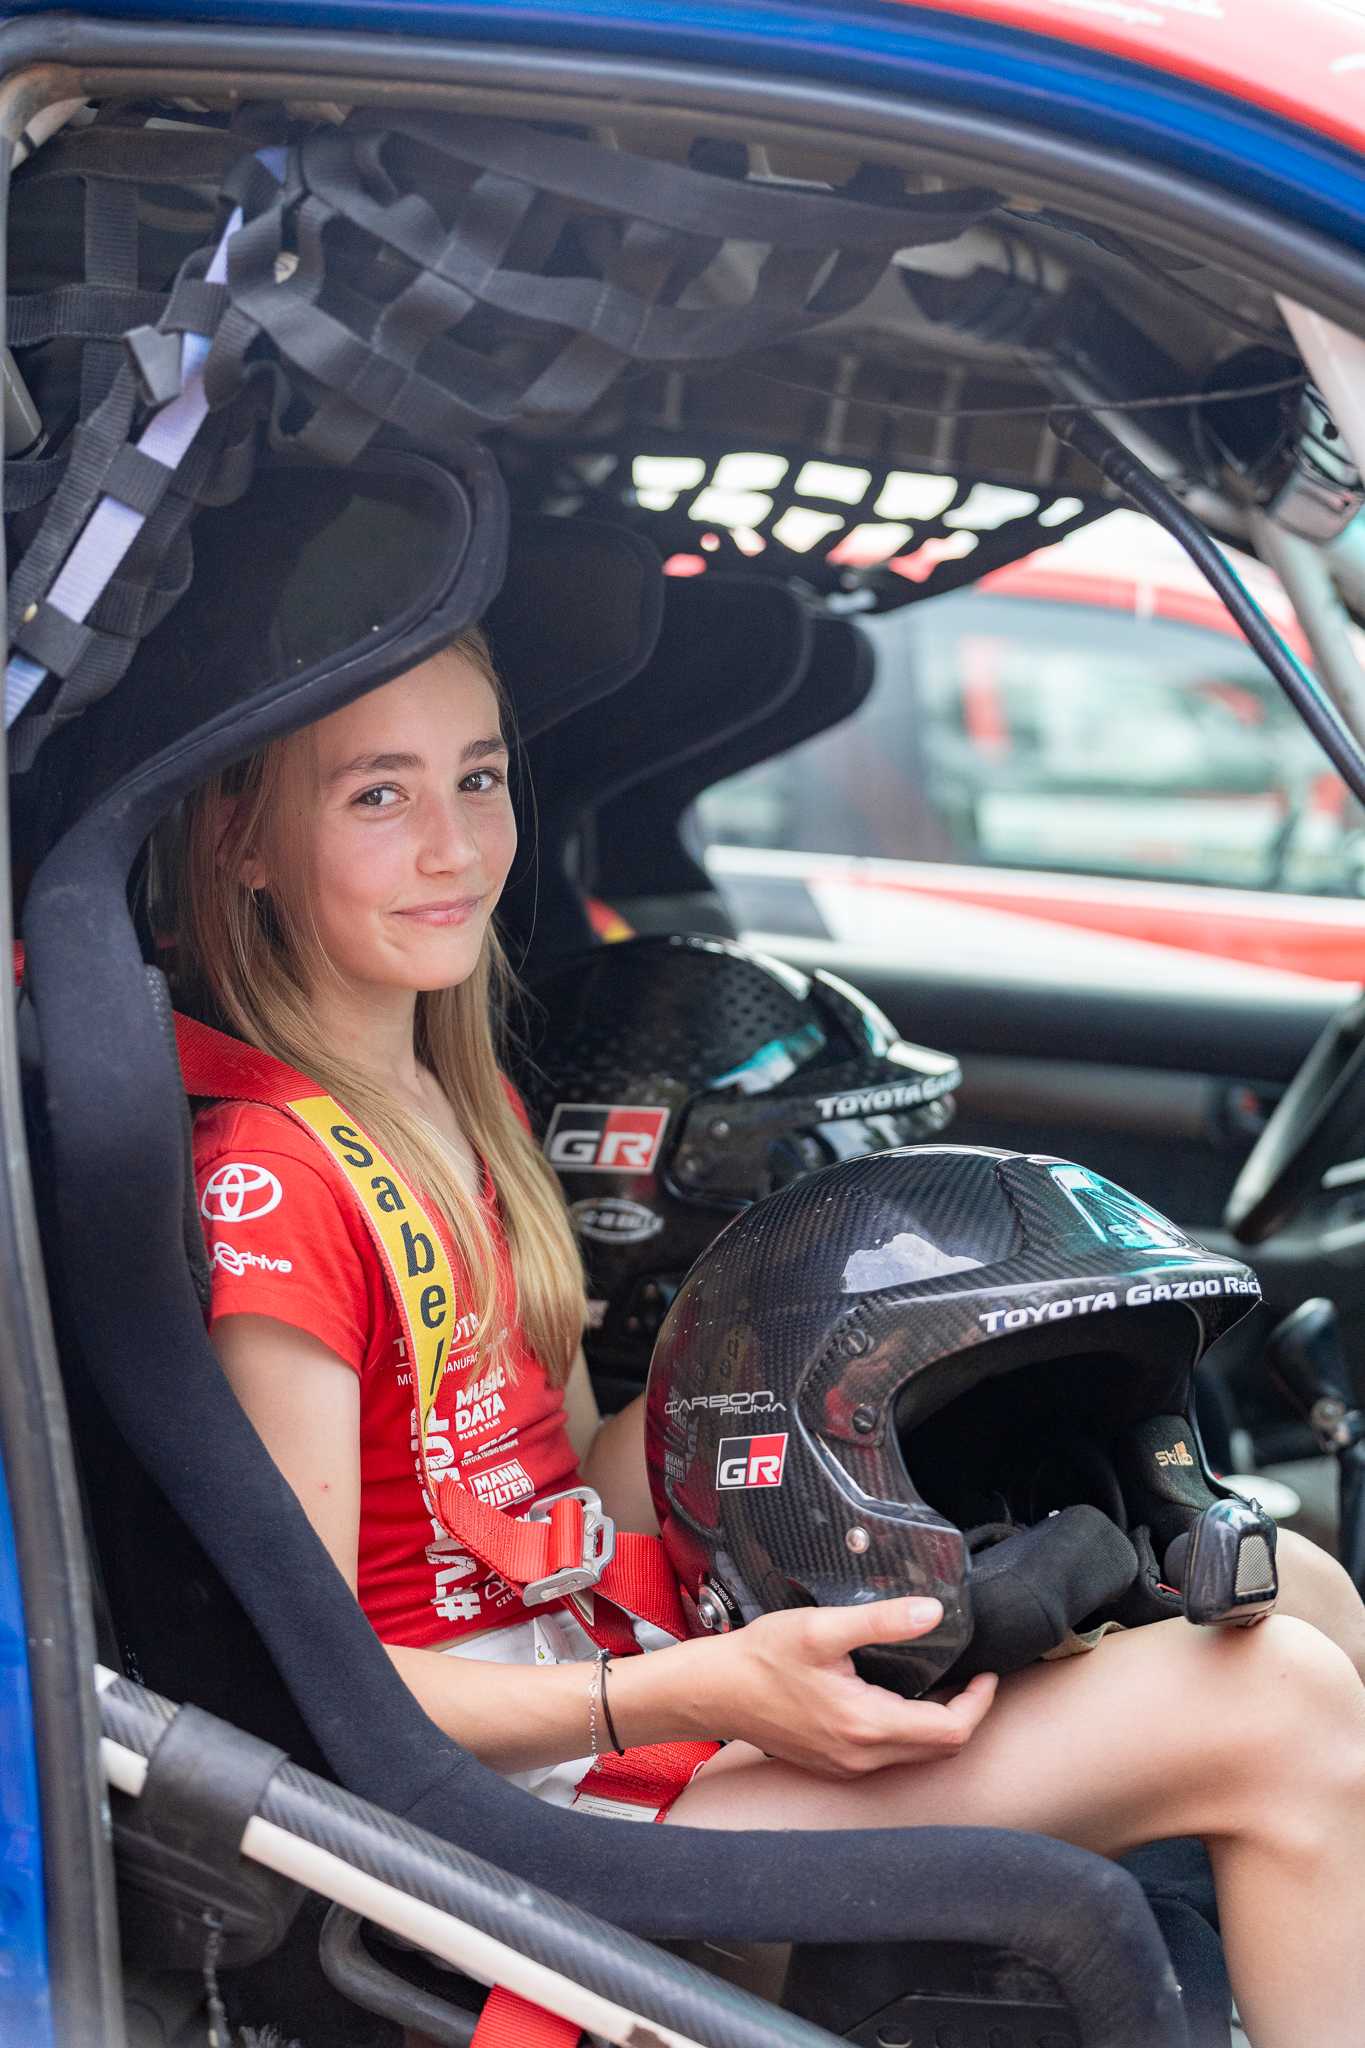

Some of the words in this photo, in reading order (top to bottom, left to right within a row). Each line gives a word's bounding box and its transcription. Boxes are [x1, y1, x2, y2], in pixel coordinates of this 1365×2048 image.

[815, 1084, 922, 1119] TOYOTA
[550, 1130, 656, 1167] GR
[330, 1125, 457, 1433] Sabel
[979, 1291, 1117, 1333] TOYOTA
[1125, 1279, 1221, 1307] GAZOO
[1224, 1276, 1262, 1294] Raci
[456, 1366, 506, 1410] MUSIC
[664, 1390, 774, 1414] CARBON
[455, 1392, 506, 1432] DATA
[720, 1403, 787, 1416] PIUMA
[458, 1428, 478, 1441] PLUG
[484, 1417, 500, 1430] PLAY
[460, 1453, 482, 1466] TOYOTA
[499, 1438, 519, 1452] EUROPE
[473, 1463, 524, 1495] MANN
[719, 1455, 781, 1486] GR
[478, 1477, 532, 1507] FILTER
[496, 1590, 517, 1607] CZEC
